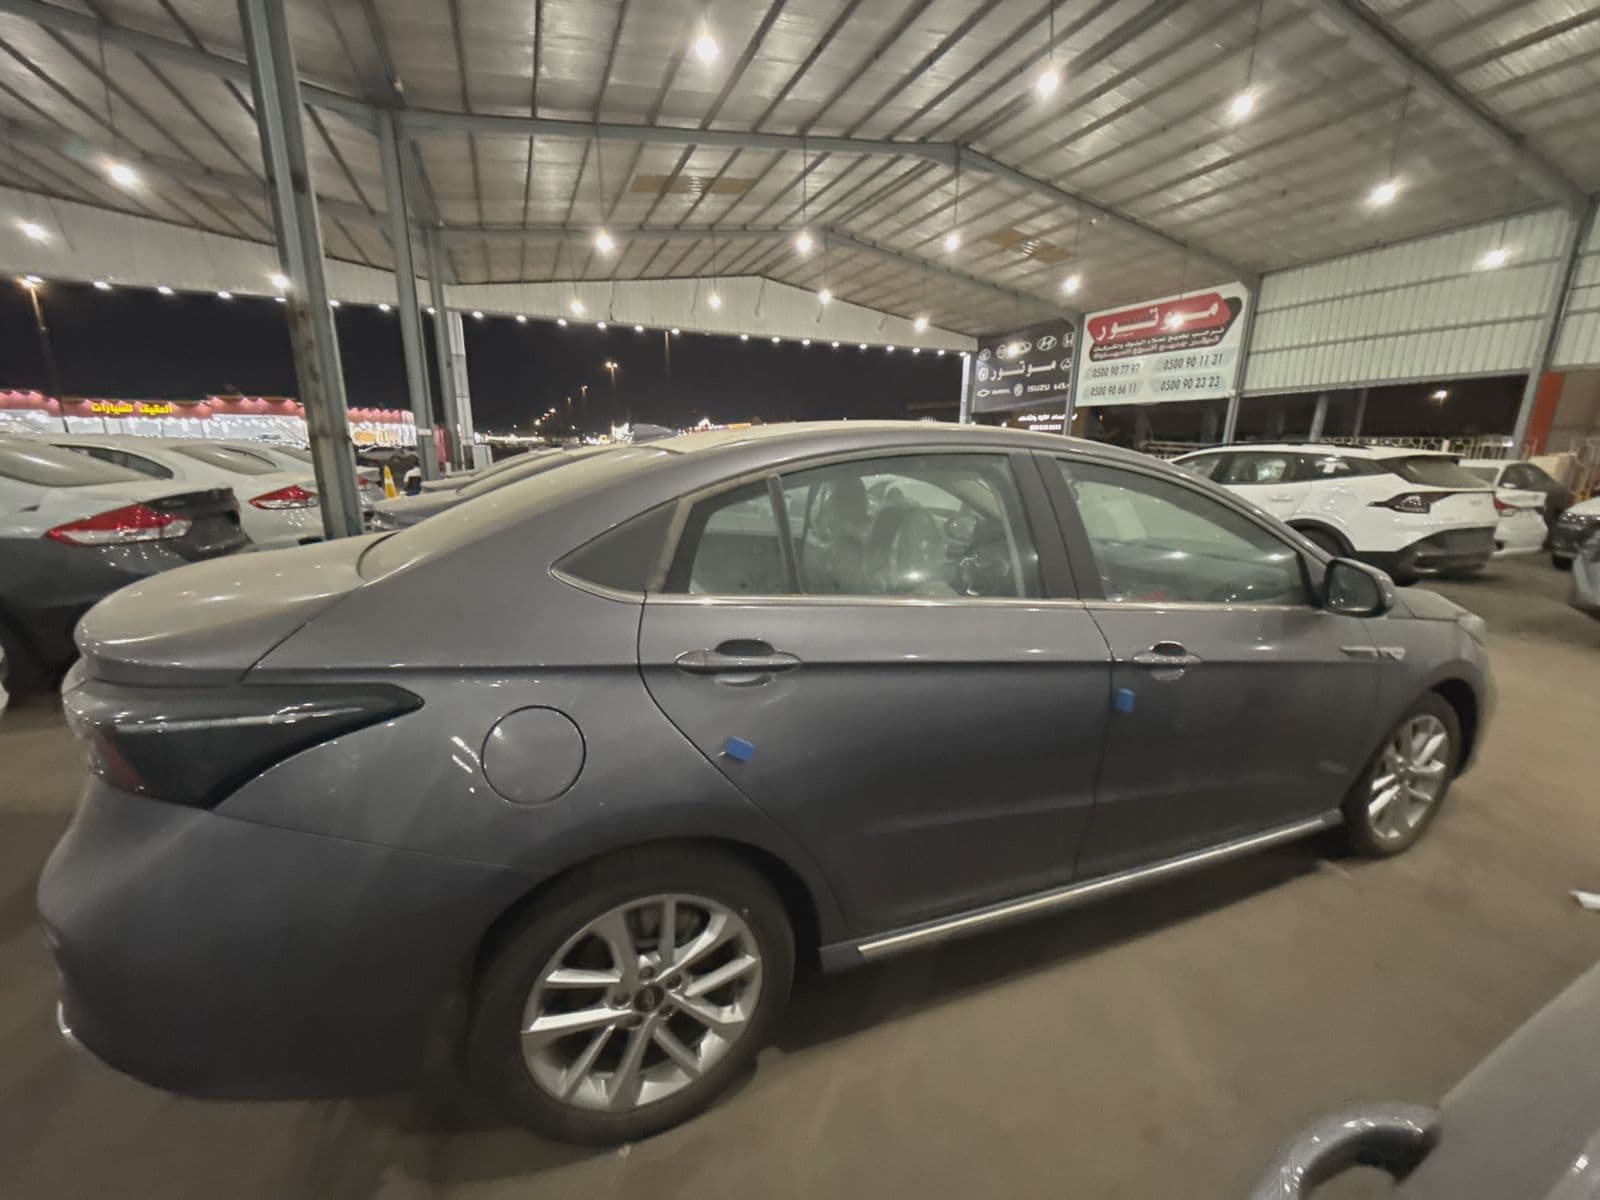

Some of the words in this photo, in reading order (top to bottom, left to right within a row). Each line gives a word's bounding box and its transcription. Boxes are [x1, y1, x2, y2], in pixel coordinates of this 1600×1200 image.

[1163, 358, 1184, 370] 0500
[1186, 356, 1197, 368] 90
[1200, 355, 1209, 367] 11
[1211, 353, 1223, 366] 31
[1027, 384, 1051, 392] ISUZU
[1160, 379, 1181, 391] 0500
[1182, 378, 1194, 390] 90
[1195, 377, 1207, 389] 23
[1208, 375, 1221, 388] 23
